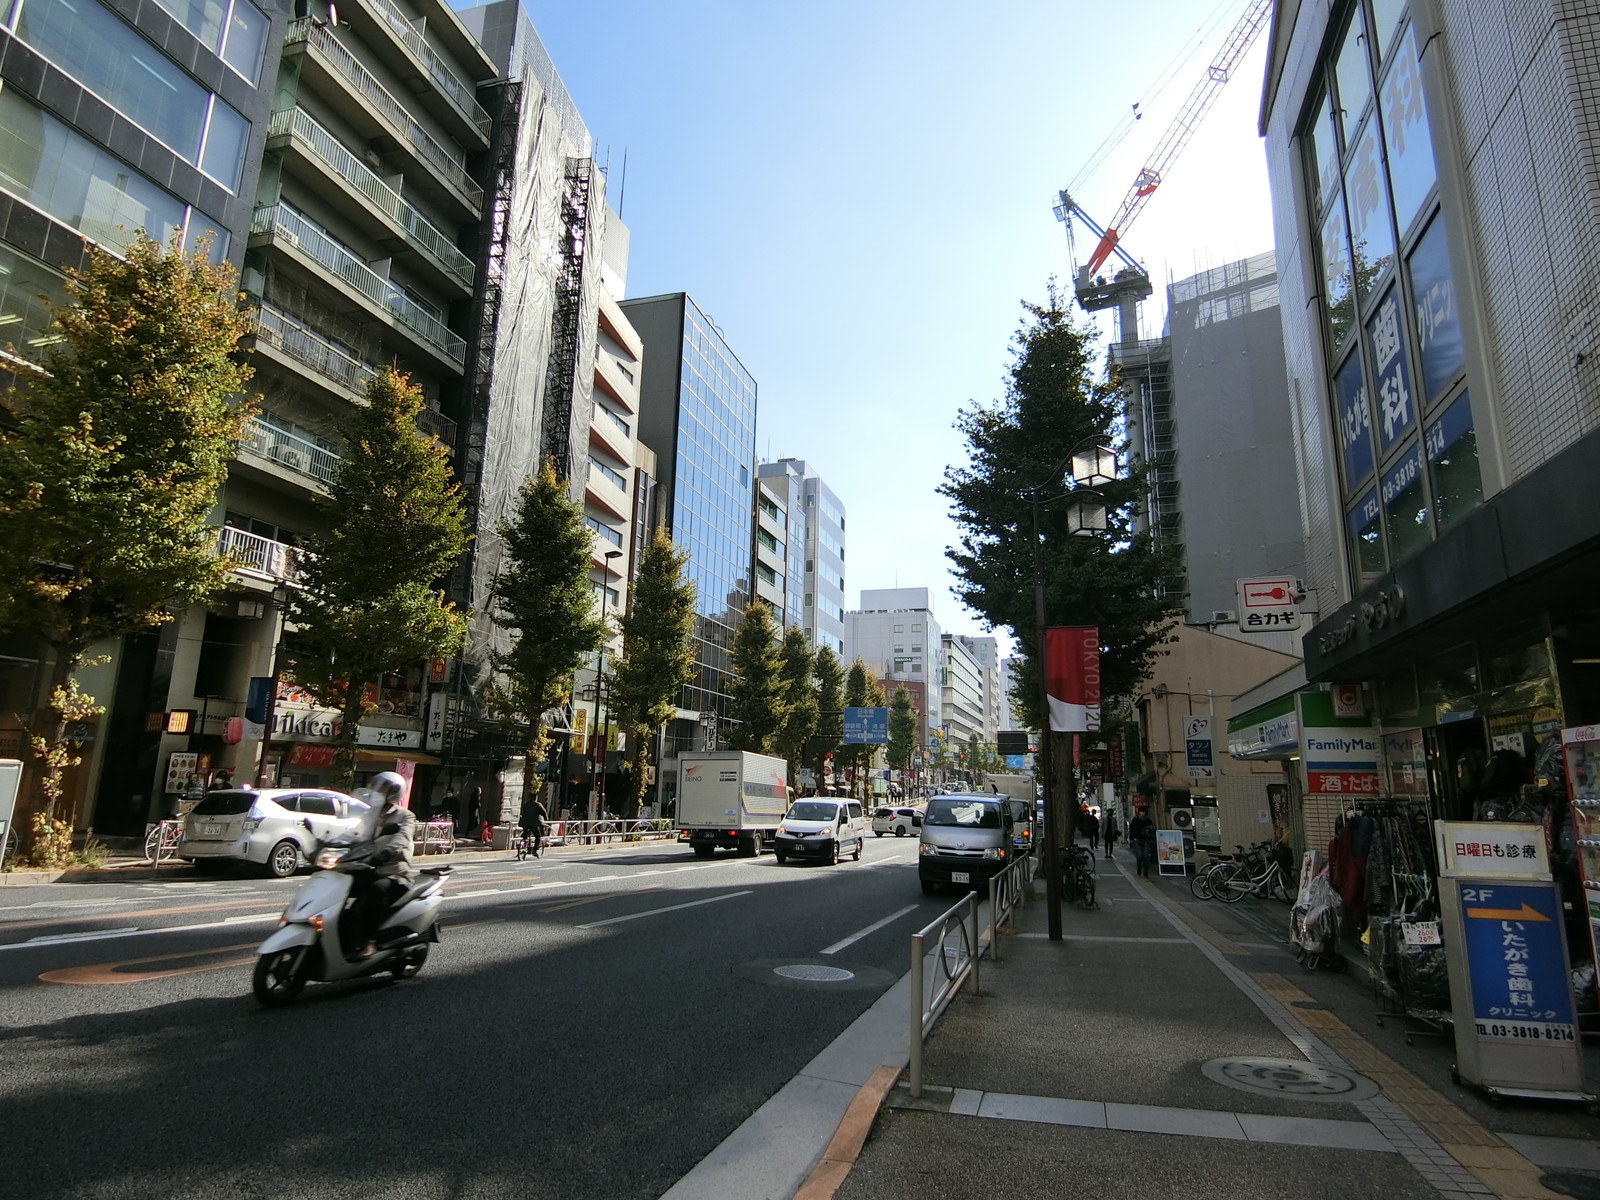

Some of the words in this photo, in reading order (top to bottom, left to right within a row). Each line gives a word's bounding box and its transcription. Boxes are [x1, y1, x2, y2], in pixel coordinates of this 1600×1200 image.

[1417, 279, 1453, 353] クリニッ
[1373, 296, 1408, 440] 歯科
[1246, 611, 1295, 626] 合カギ
[1083, 628, 1098, 686] TOKYO
[1086, 688, 1101, 732] 2020
[1455, 843, 1537, 859] 日曜日も診療
[1462, 888, 1494, 902] 2F
[1500, 920, 1536, 1007] いたがき歯科
[1488, 1006, 1557, 1019] クリニック
